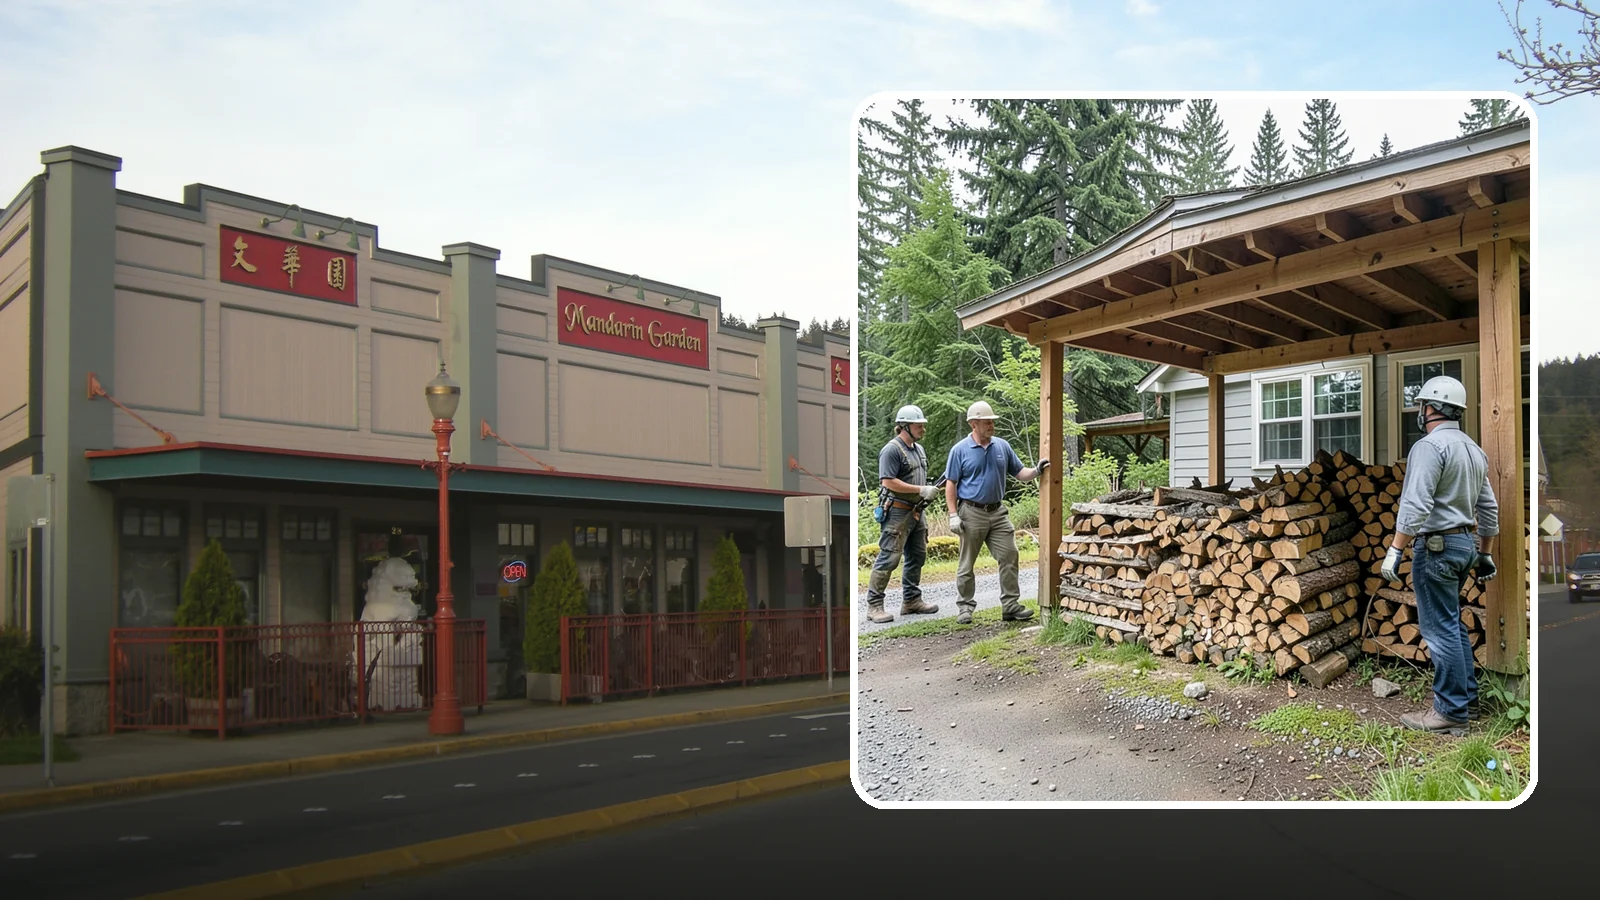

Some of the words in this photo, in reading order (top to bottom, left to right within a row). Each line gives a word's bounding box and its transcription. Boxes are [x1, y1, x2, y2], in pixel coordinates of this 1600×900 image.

[231, 236, 346, 291] 文華園
[564, 302, 644, 341] Mandarin
[648, 320, 702, 352] Garden
[504, 565, 527, 578] OPEN
